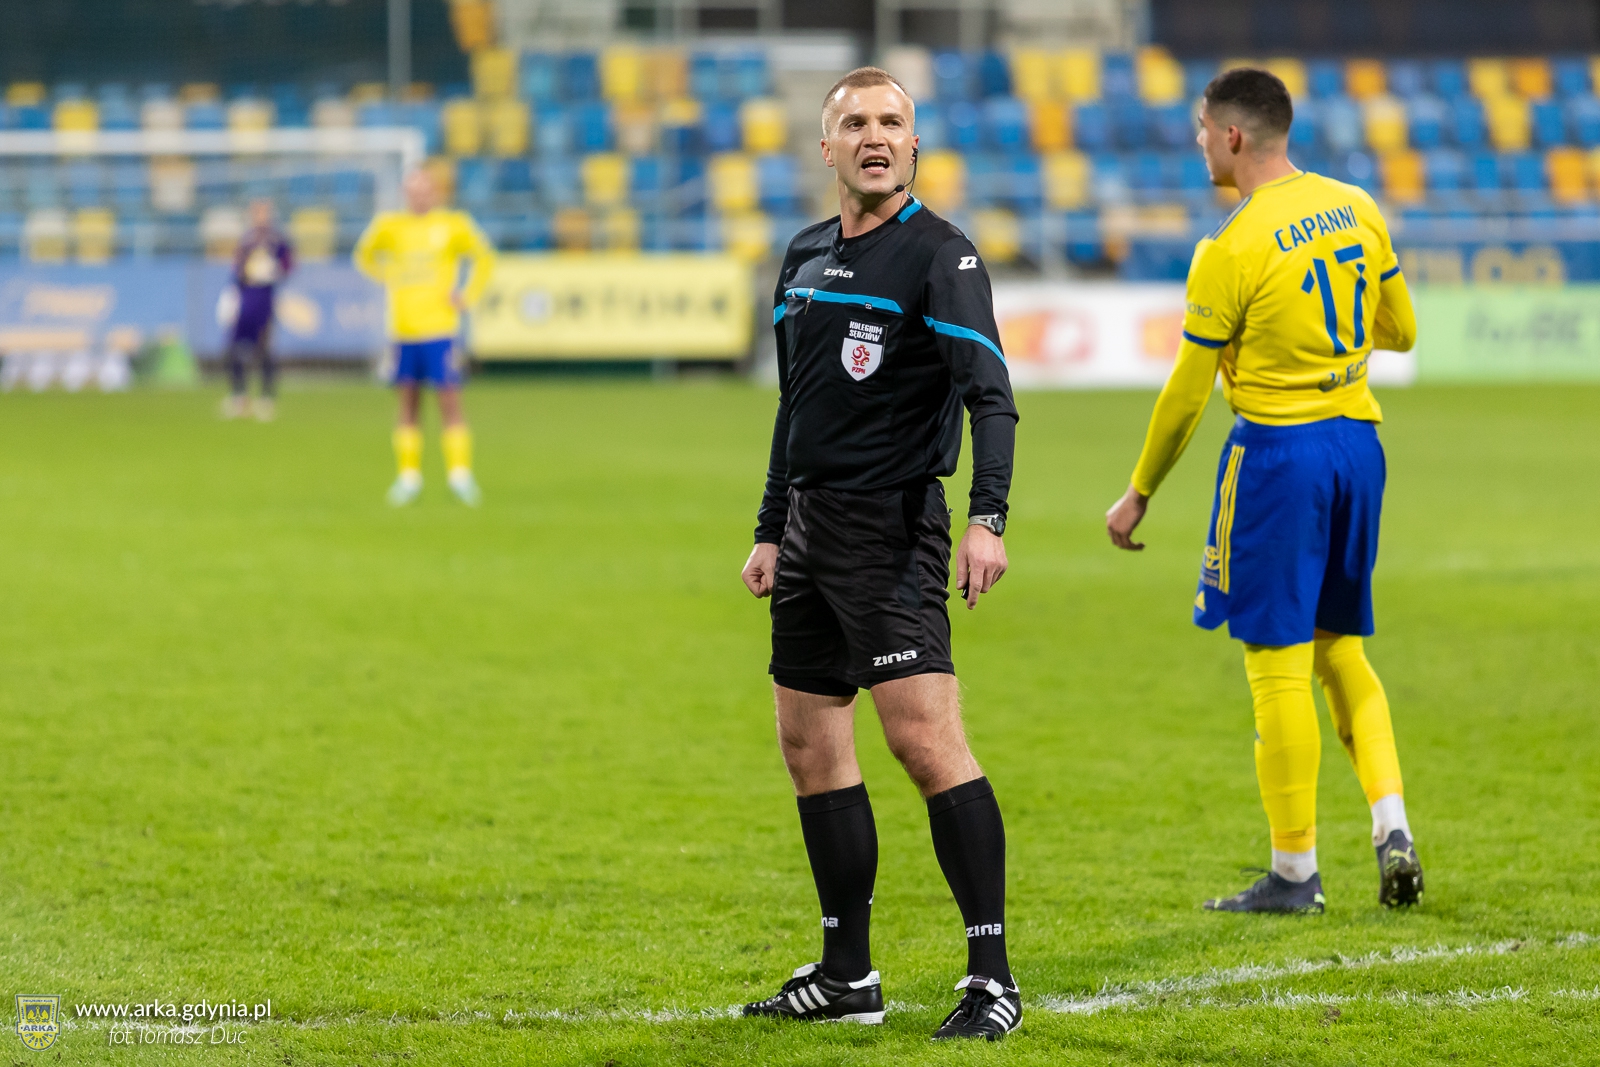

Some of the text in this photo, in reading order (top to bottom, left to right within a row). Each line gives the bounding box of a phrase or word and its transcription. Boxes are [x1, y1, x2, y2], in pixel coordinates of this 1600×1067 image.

[1274, 205, 1357, 252] CAPANNI
[823, 268, 854, 278] zina
[1301, 244, 1367, 355] 17
[849, 321, 883, 334] KOLEGIUM
[851, 366, 866, 375] PZPN
[873, 650, 917, 667] zina
[966, 923, 1002, 938] zina
